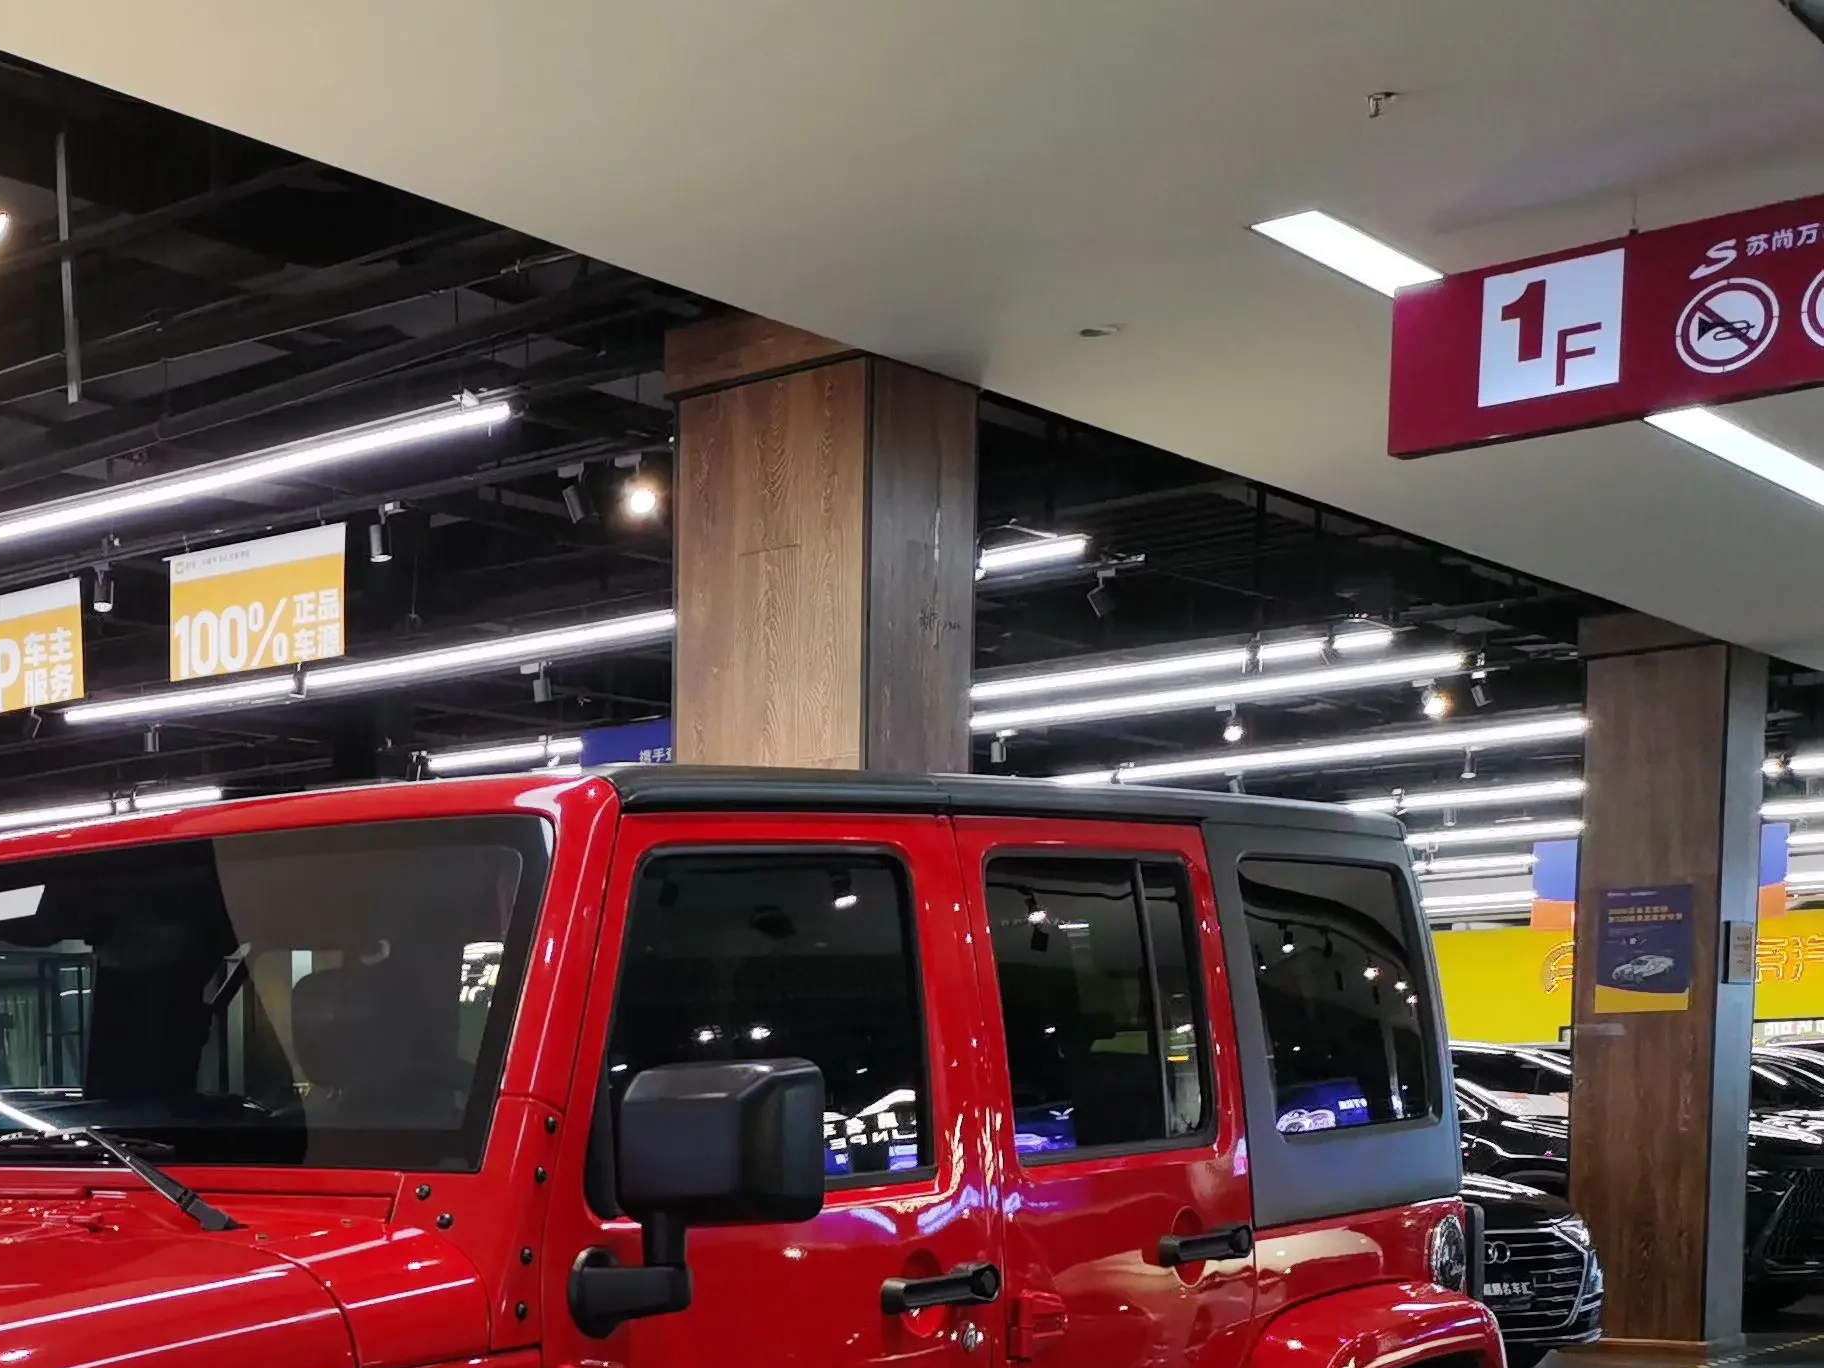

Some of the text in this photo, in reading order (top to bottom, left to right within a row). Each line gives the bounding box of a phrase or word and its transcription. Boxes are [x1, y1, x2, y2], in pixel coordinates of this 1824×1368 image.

[1745, 223, 1824, 256] 苏尚万
[1501, 279, 1601, 386] 1F
[293, 588, 339, 626] 正品
[24, 627, 73, 666] 车主
[175, 597, 288, 677] 100%
[24, 664, 74, 706] 服务
